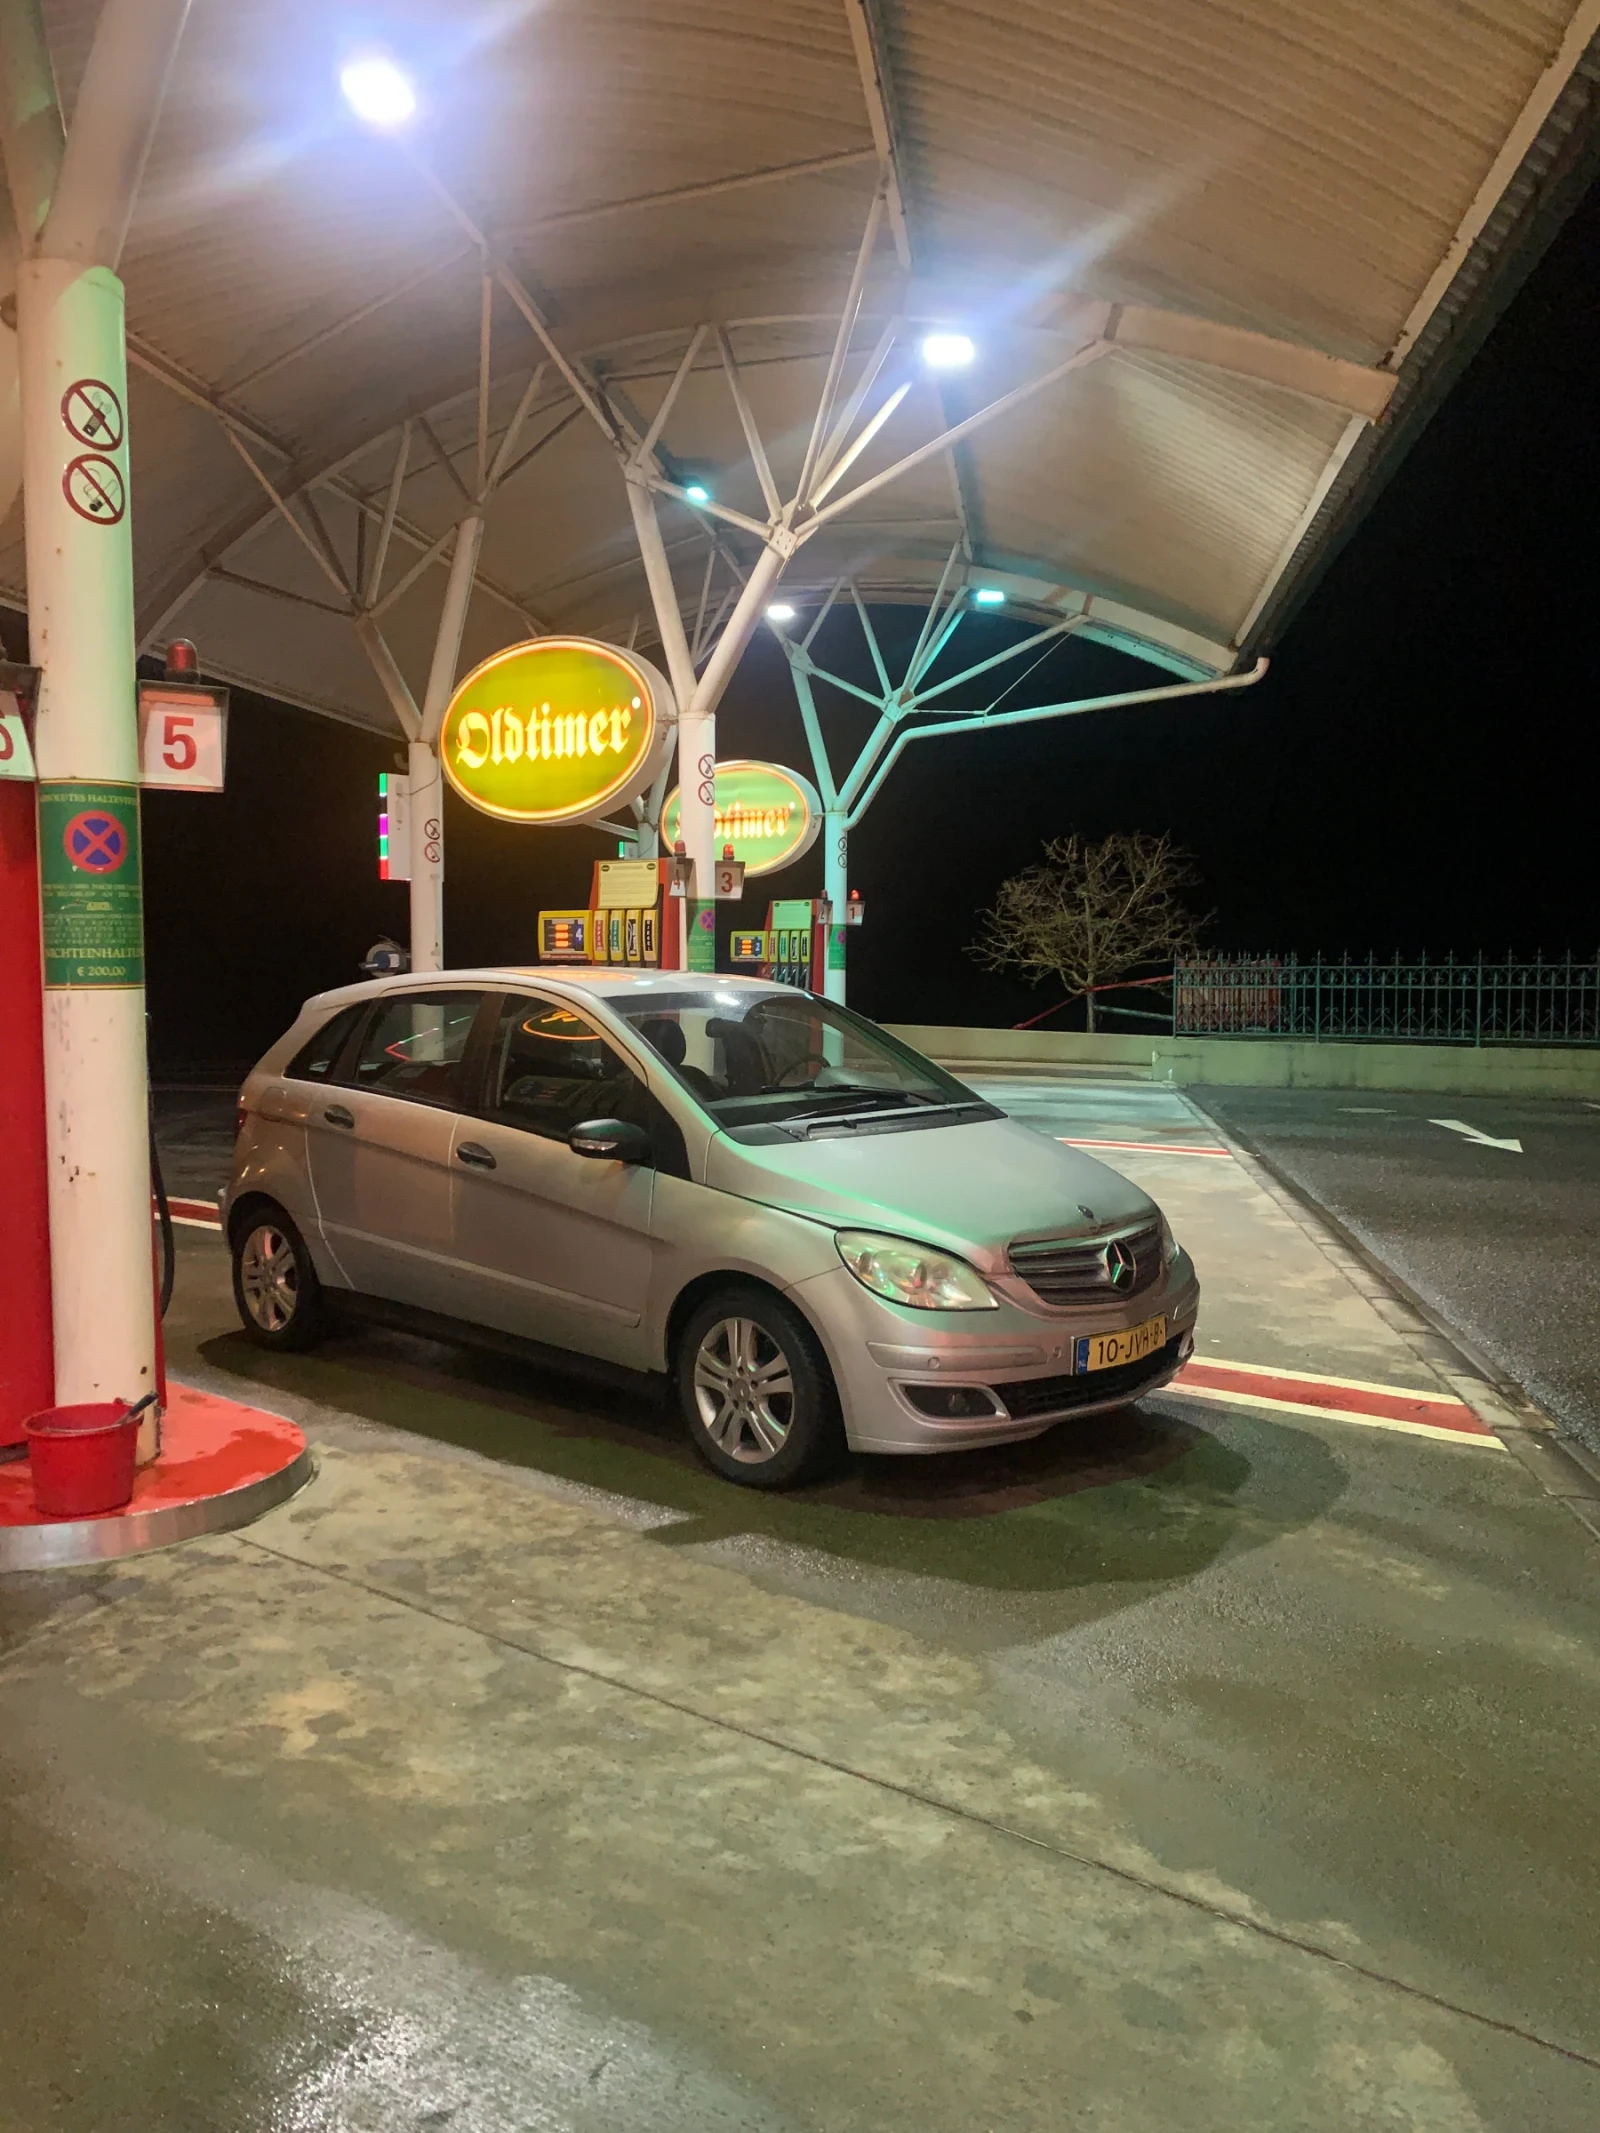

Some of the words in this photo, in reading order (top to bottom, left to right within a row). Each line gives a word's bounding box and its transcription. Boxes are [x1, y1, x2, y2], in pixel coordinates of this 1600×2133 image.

[162, 715, 197, 771] 5
[455, 701, 633, 769] Oldtimer
[721, 871, 733, 893] 3
[849, 906, 856, 920] 1
[575, 927, 583, 941] 4
[755, 942, 761, 951] 2
